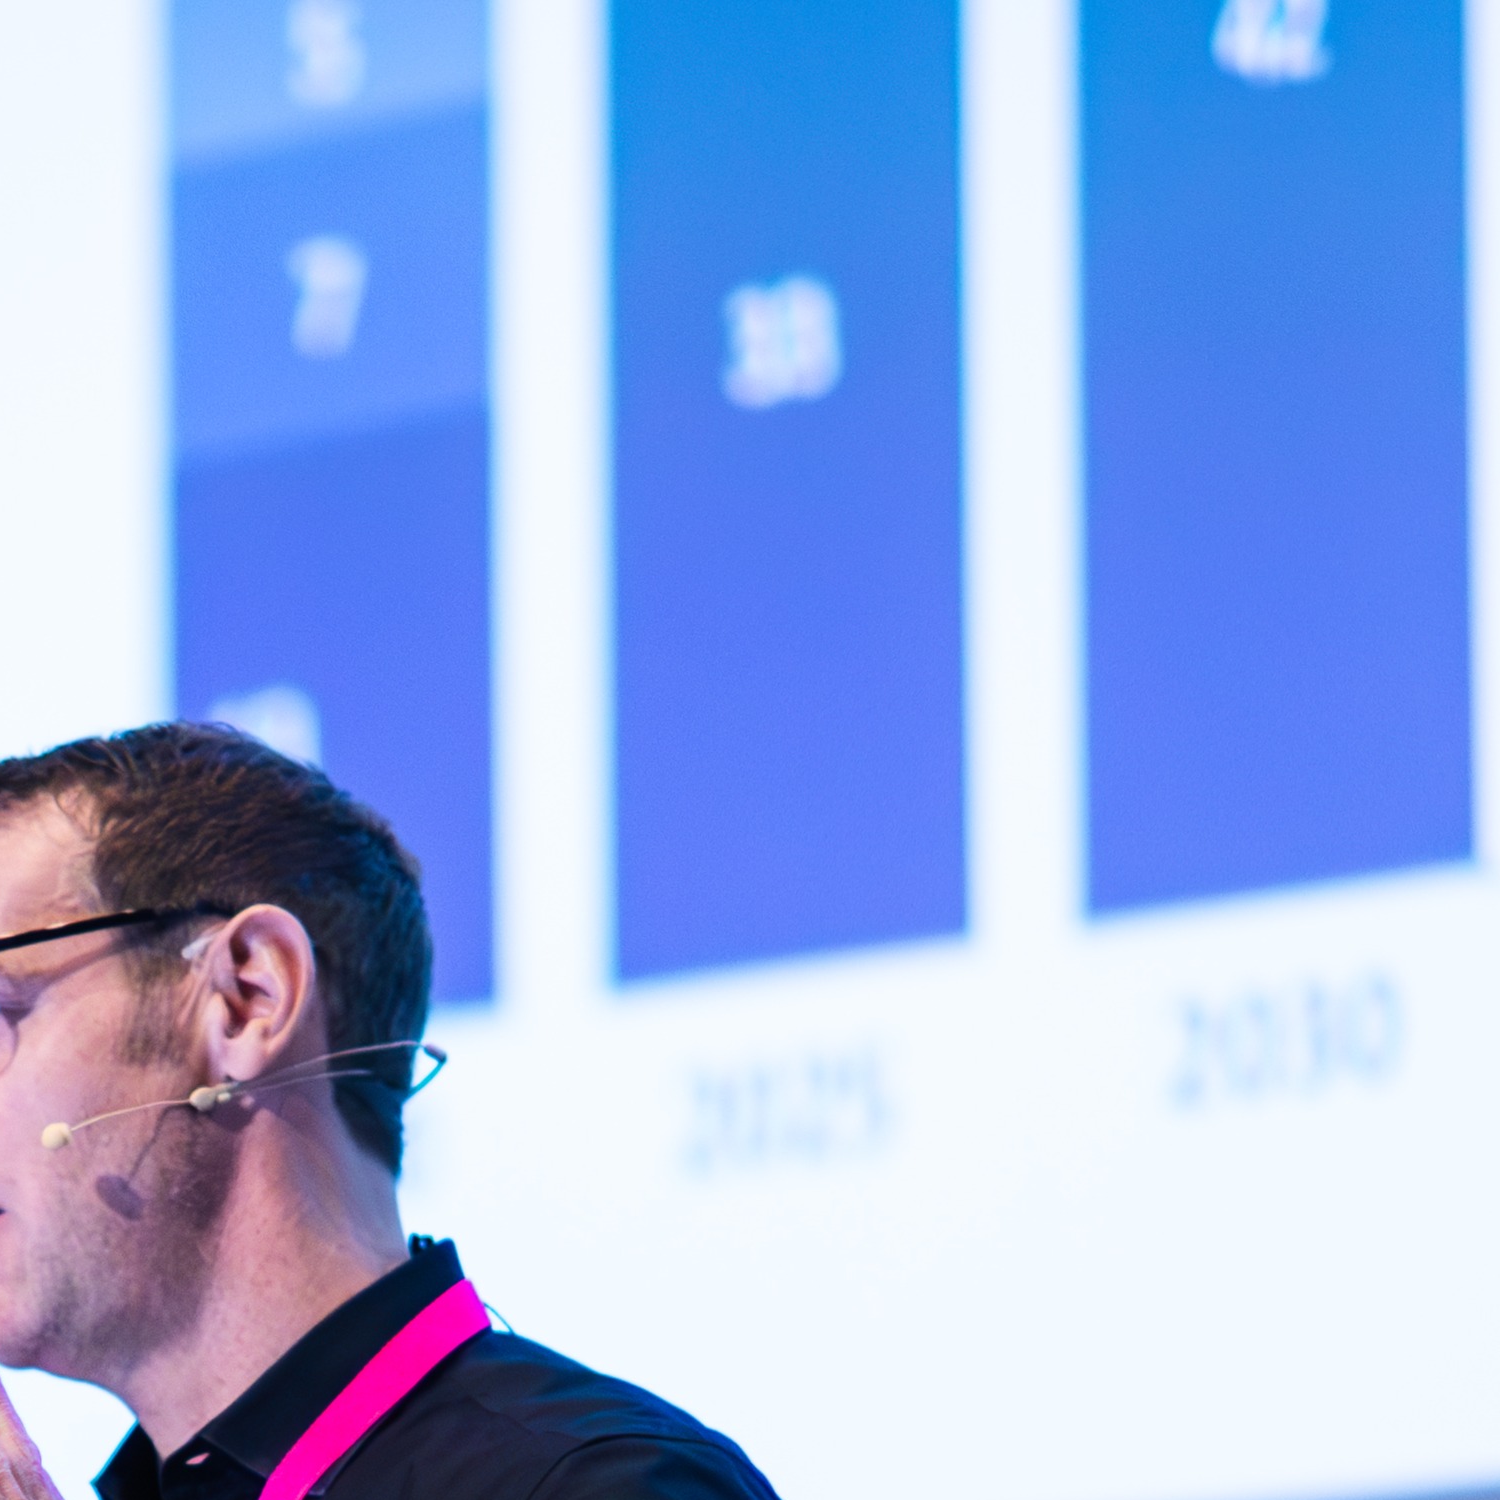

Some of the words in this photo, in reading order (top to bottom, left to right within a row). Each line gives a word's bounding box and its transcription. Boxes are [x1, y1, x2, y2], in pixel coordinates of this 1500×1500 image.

[285, 234, 368, 361] 7
[684, 1038, 900, 1180] 2025
[1168, 974, 1403, 1112] 2030
